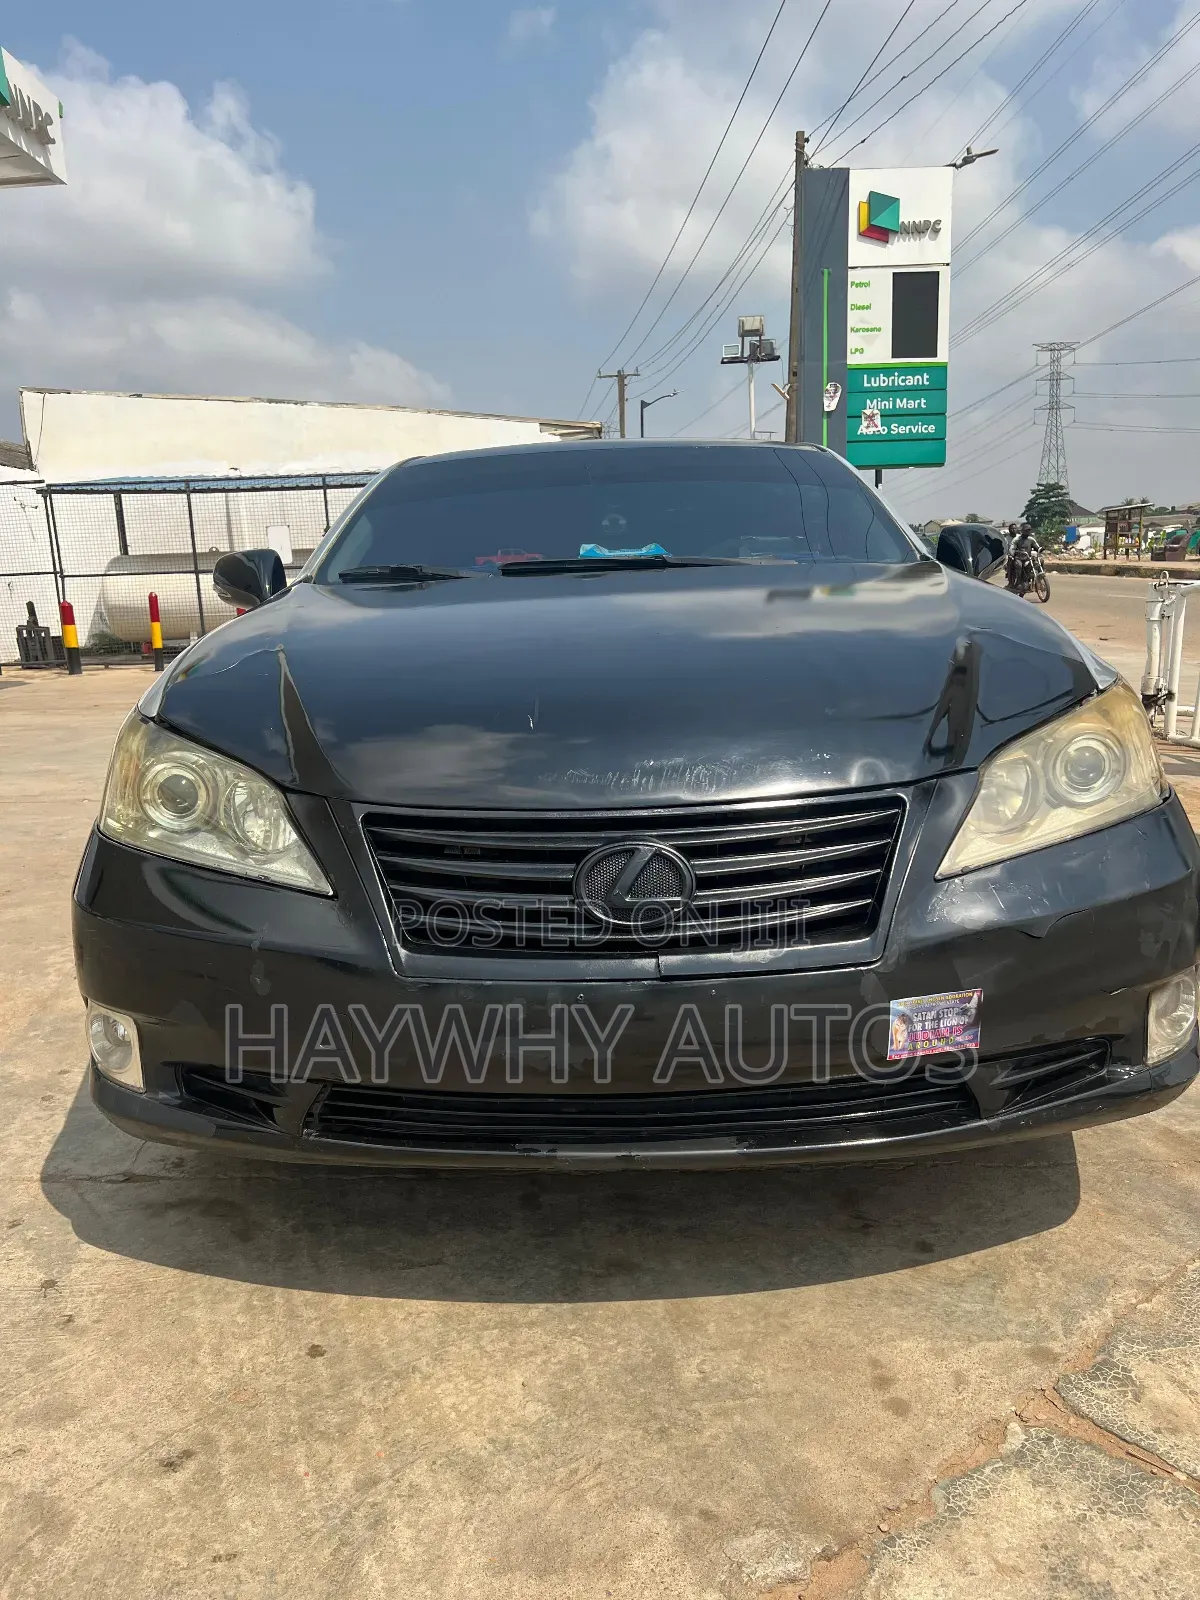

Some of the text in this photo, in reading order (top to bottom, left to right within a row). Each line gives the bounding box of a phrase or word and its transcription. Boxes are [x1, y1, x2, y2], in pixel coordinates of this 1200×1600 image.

[900, 219, 942, 235] NNPC
[850, 303, 872, 311] Diesel
[850, 347, 864, 355] LPG
[863, 372, 930, 387] Lubricant
[866, 398, 927, 410] Mini Mart
[890, 422, 936, 434] Service
[912, 1008, 959, 1021] SATAN STOP
[908, 1022, 922, 1032] FOR
[925, 1020, 938, 1029] THE
[940, 1017, 958, 1027] LION
[952, 1026, 963, 1036] IS
[908, 1036, 954, 1050] AROUND
